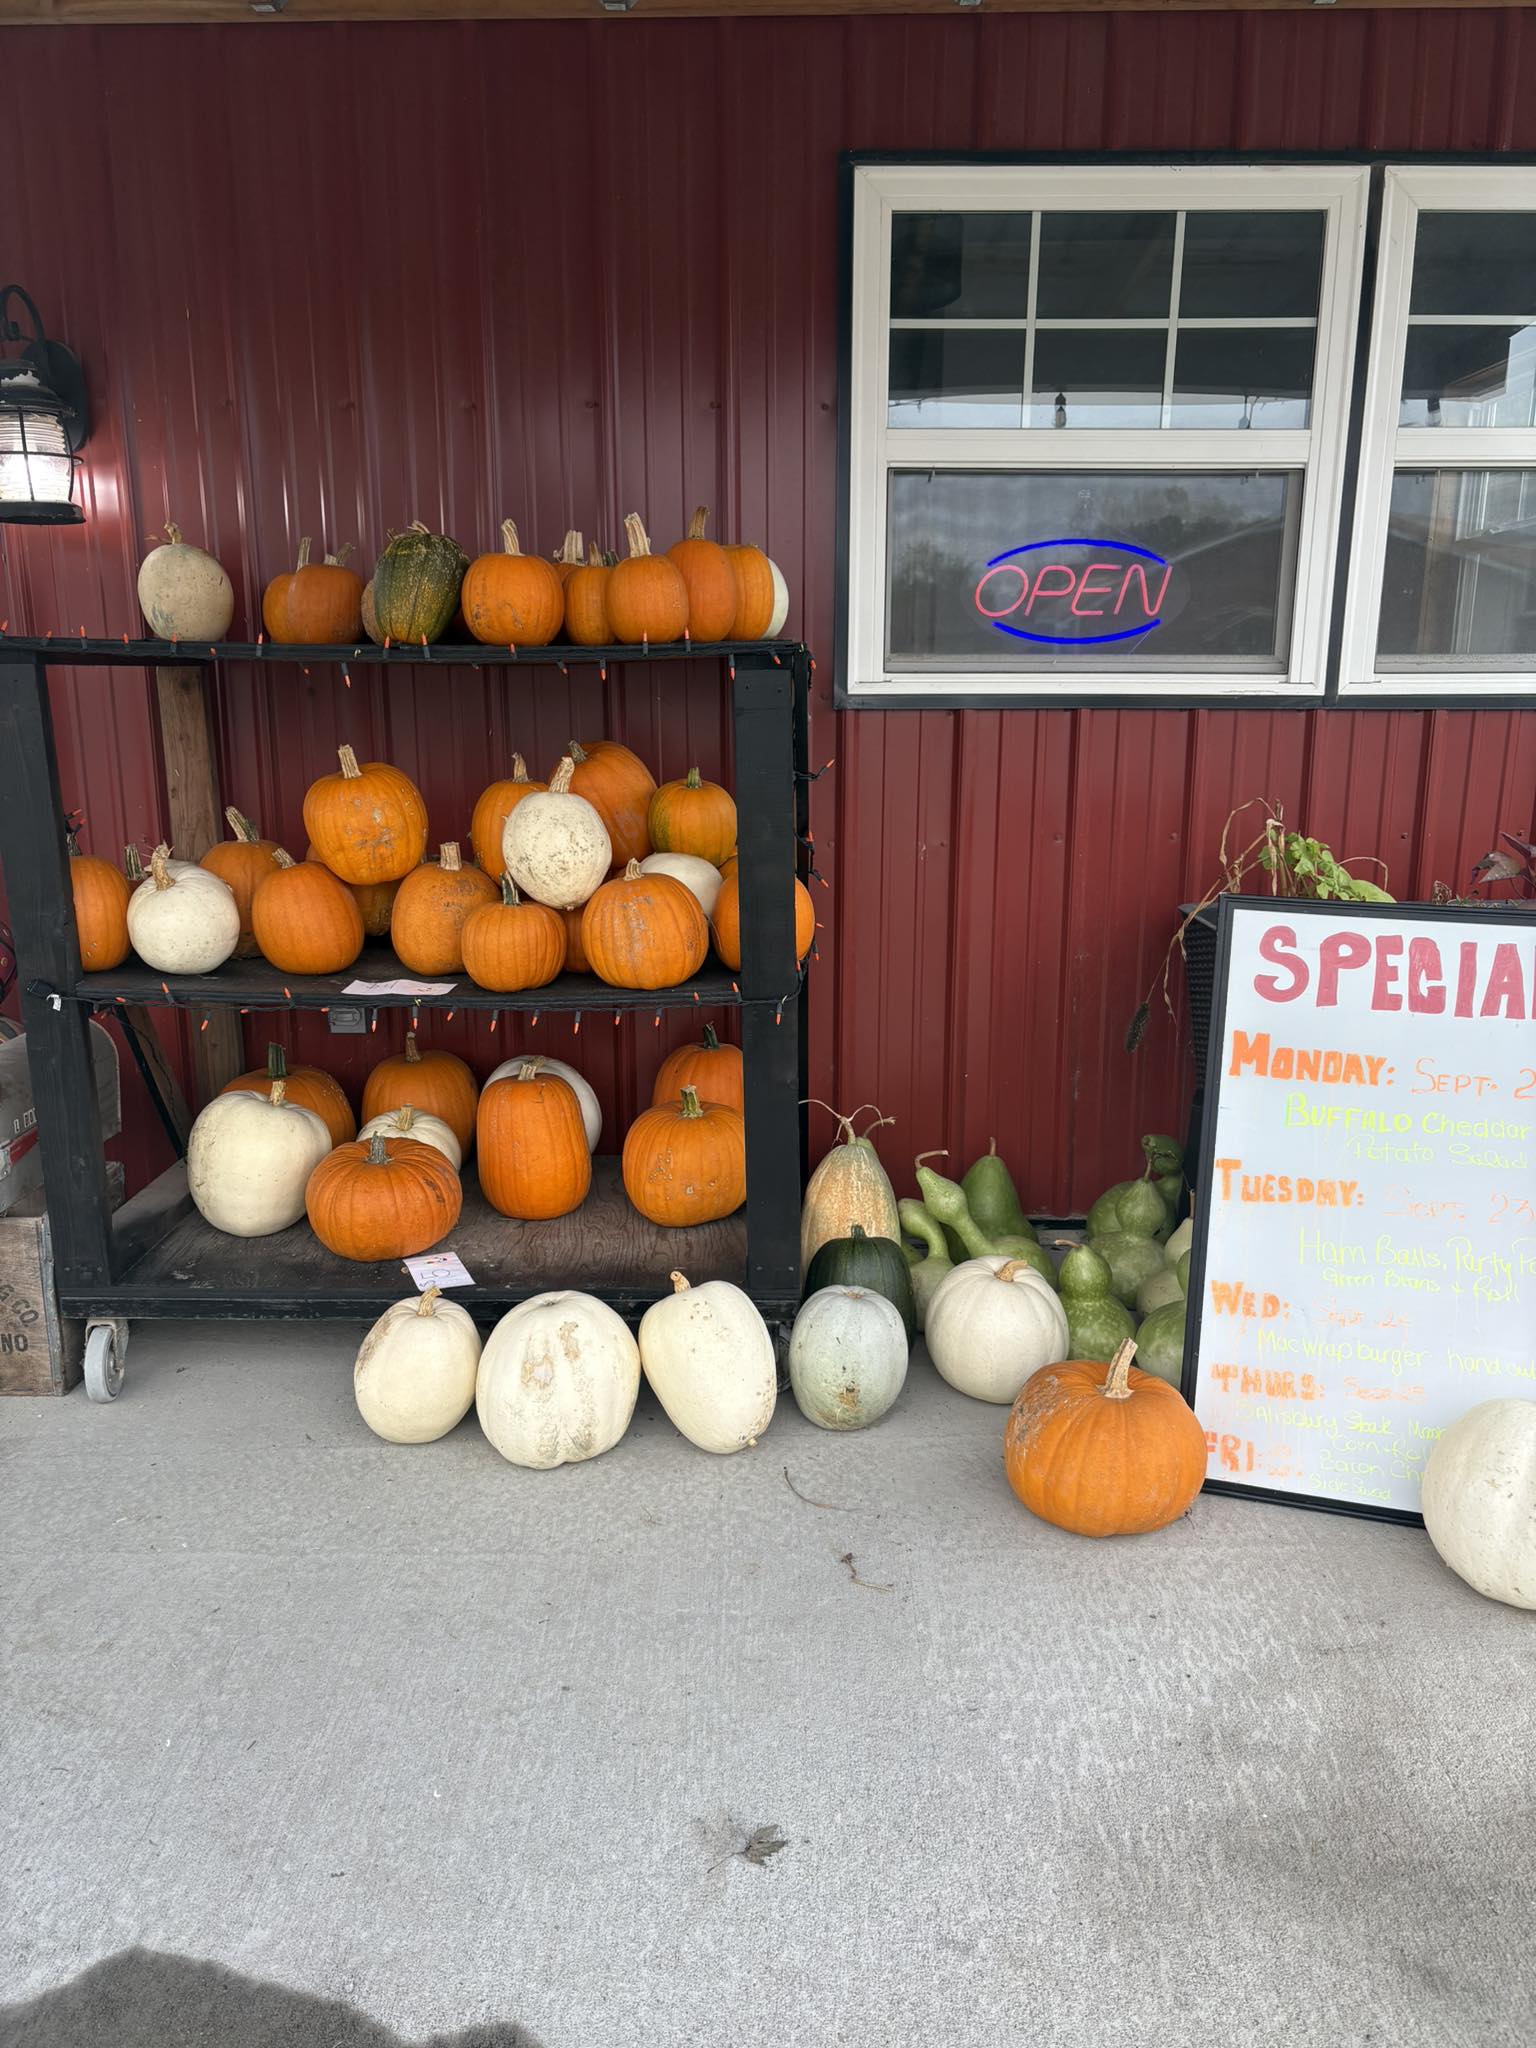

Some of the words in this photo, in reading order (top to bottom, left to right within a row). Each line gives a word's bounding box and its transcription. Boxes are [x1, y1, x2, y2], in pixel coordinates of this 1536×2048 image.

[975, 564, 1173, 617] OPEN
[1254, 925, 1536, 1020] SPECIA
[1228, 1030, 1395, 1086] MONDAY:
[1422, 1111, 1532, 1140] Cheddar
[1215, 1158, 1365, 1206] TUESDAY:
[1211, 1279, 1290, 1319] WED:
